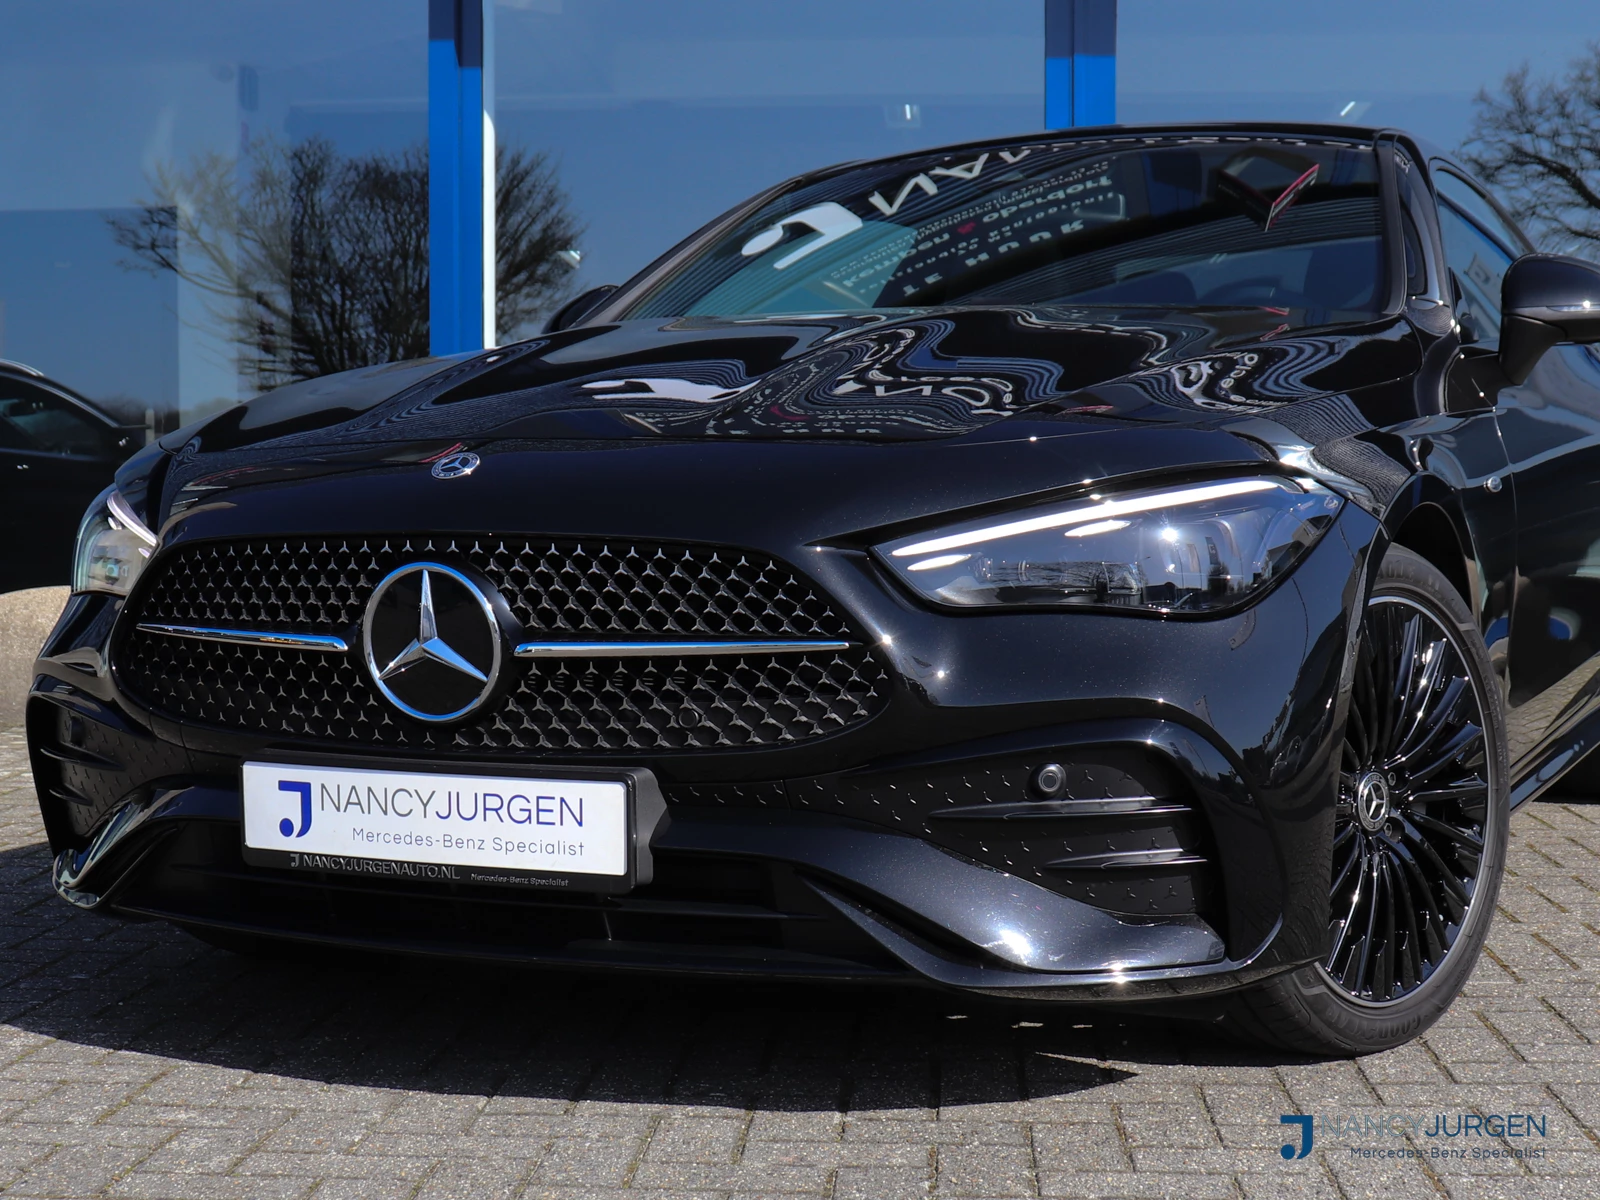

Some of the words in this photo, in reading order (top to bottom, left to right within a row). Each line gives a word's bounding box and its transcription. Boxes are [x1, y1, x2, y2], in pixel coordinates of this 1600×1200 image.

[320, 782, 583, 827] NANCYJURGEN
[352, 827, 485, 851] Mercedes-Benz
[492, 836, 585, 856] Specialist
[303, 854, 461, 880] NANCYJURGENAUTO.NL
[470, 873, 529, 885] Mercedes-Benz
[530, 877, 569, 887] Specialist
